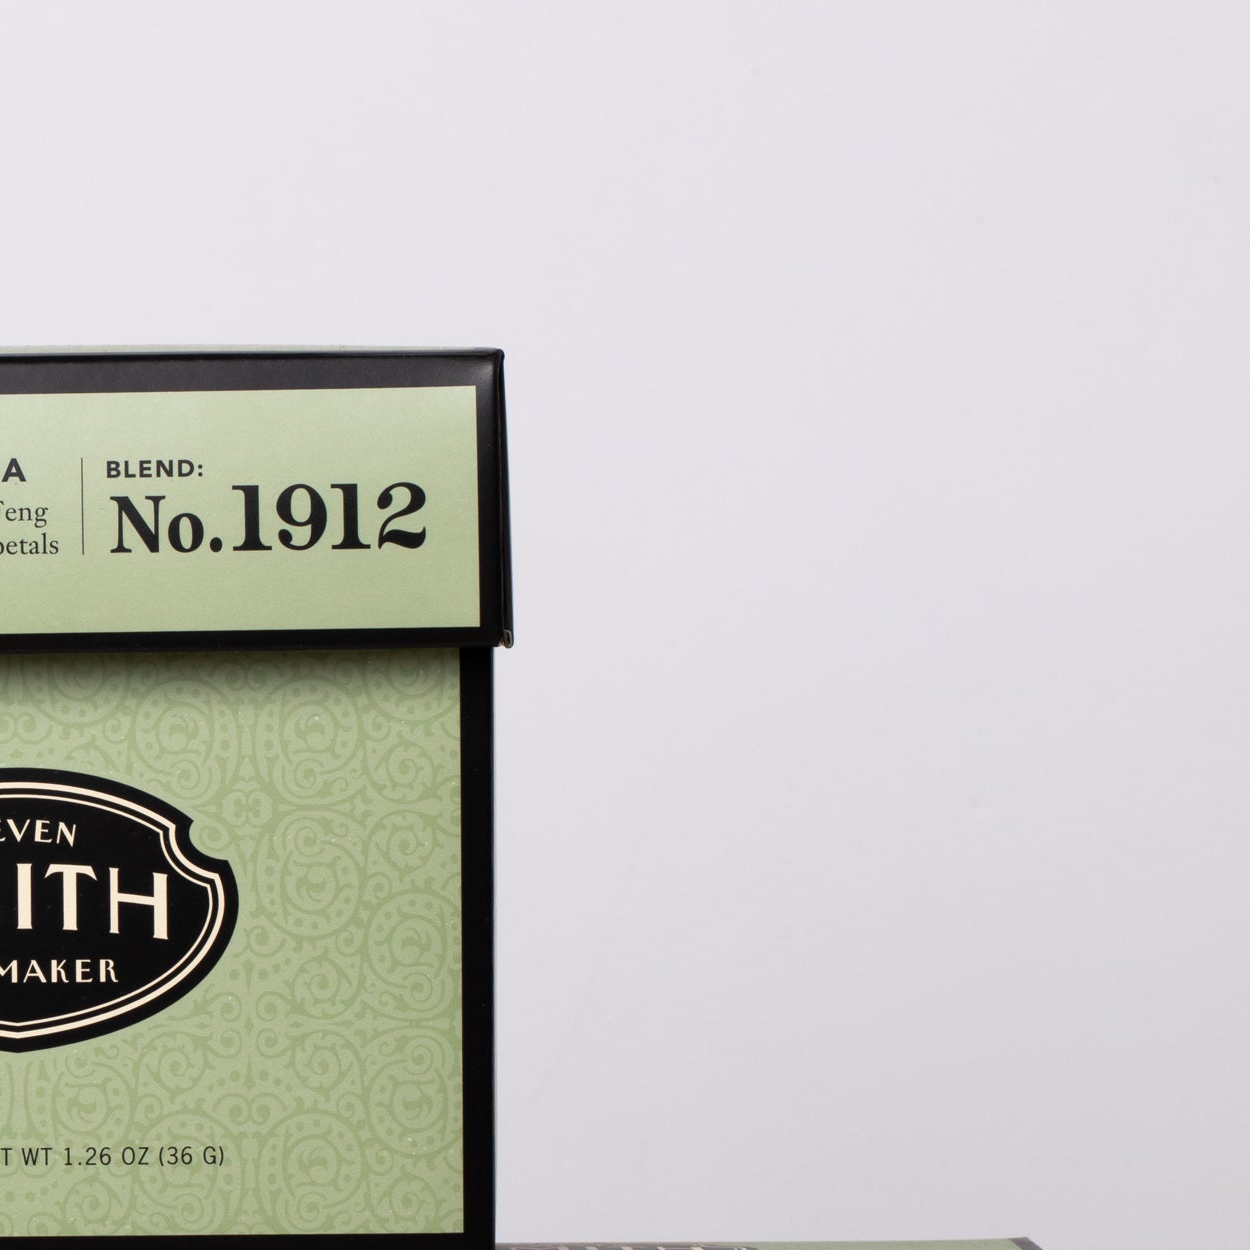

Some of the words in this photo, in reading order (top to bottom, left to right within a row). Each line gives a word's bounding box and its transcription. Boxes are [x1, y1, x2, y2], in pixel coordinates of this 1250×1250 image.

[106, 459, 204, 479] BLEND:
[21, 1147, 53, 1166] WT
[64, 1146, 112, 1166] 1.26
[121, 1146, 150, 1166] OZ
[158, 1145, 193, 1167] (36
[202, 1145, 224, 1167] G)
